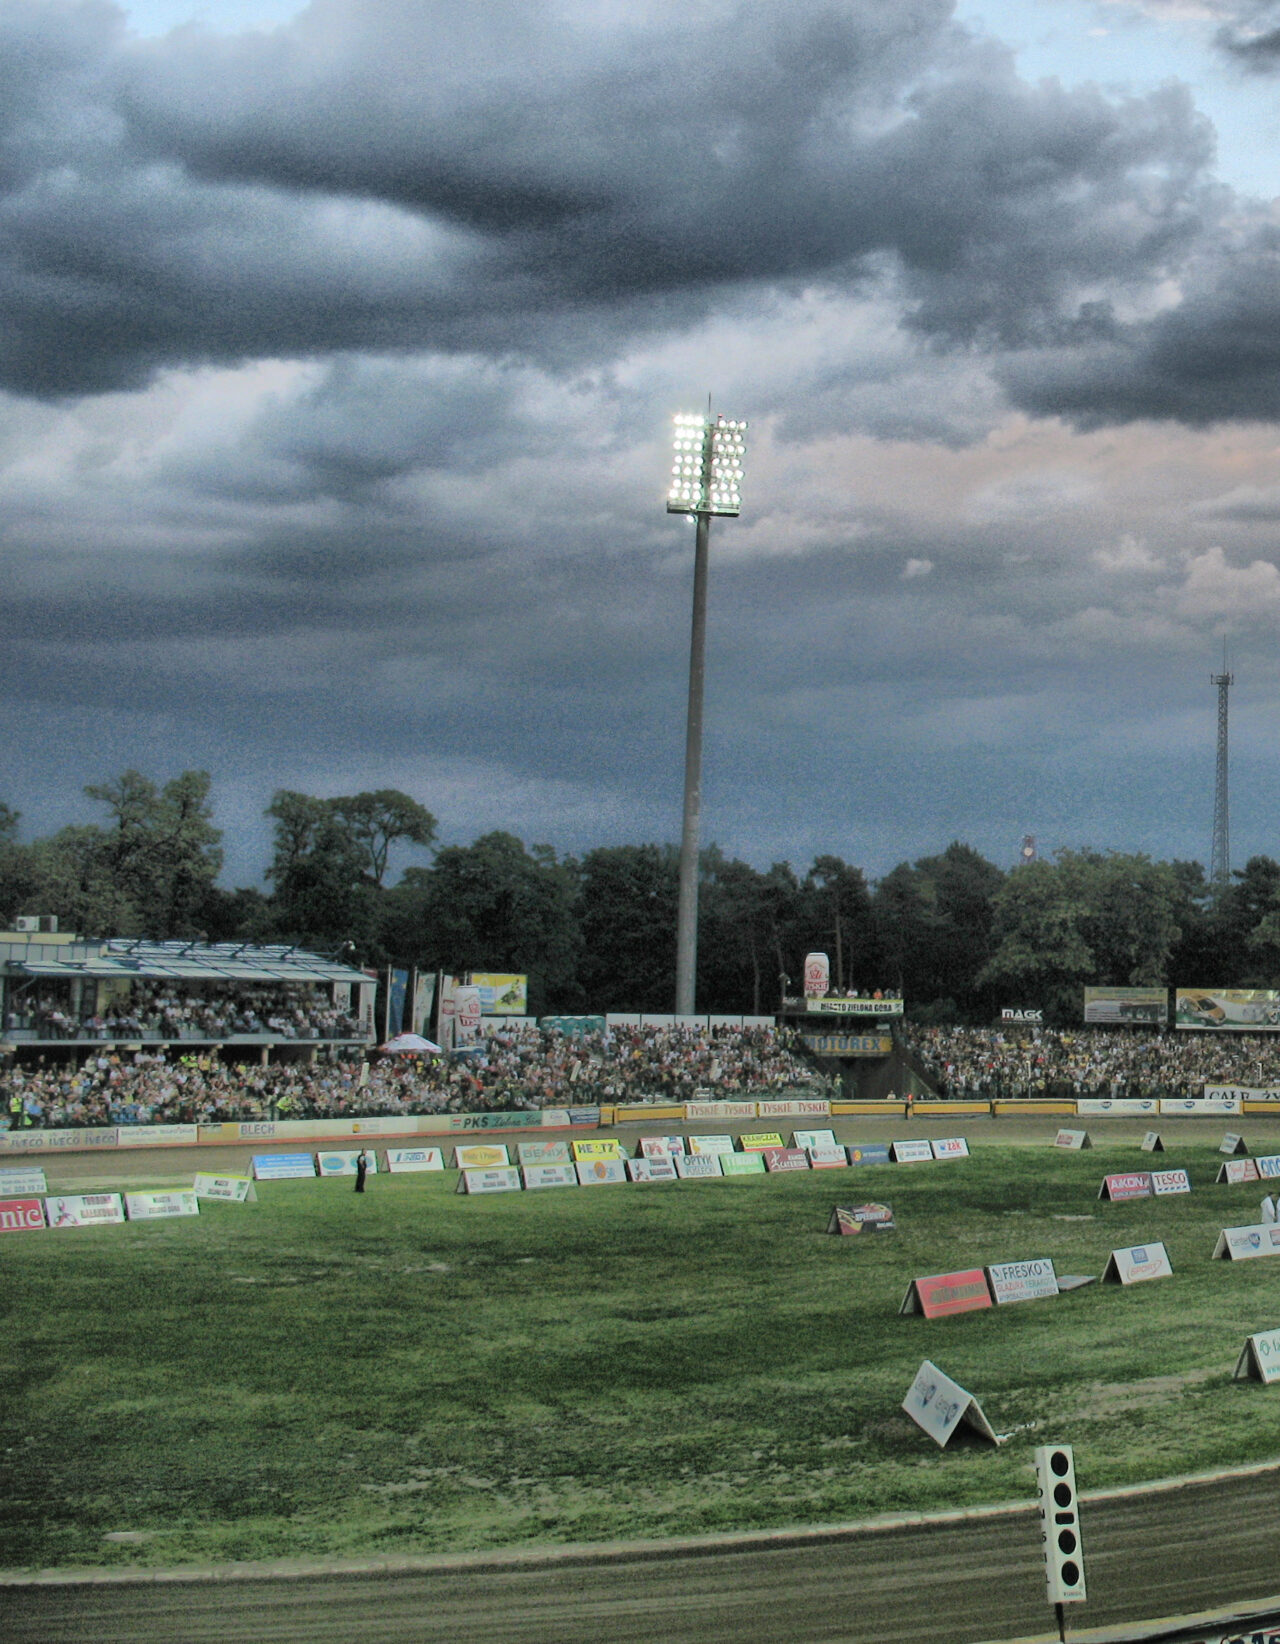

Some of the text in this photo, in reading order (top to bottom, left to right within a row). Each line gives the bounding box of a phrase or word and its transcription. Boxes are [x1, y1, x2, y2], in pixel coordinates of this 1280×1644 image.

[848, 1002, 873, 1012] ZIELONA
[803, 1036, 881, 1051] MOTOREX
[691, 1104, 753, 1115] TYSKIE TYSKIE
[763, 1101, 827, 1113] TYSKIE TYSKIE
[463, 1116, 489, 1128] PKS
[240, 1123, 275, 1135] BLECH
[11, 1135, 115, 1147] IVECO IVECO IVECO
[683, 1155, 714, 1167] OPTYK
[1154, 1172, 1186, 1185] TESCO
[1002, 1262, 1043, 1280] FRESKO
